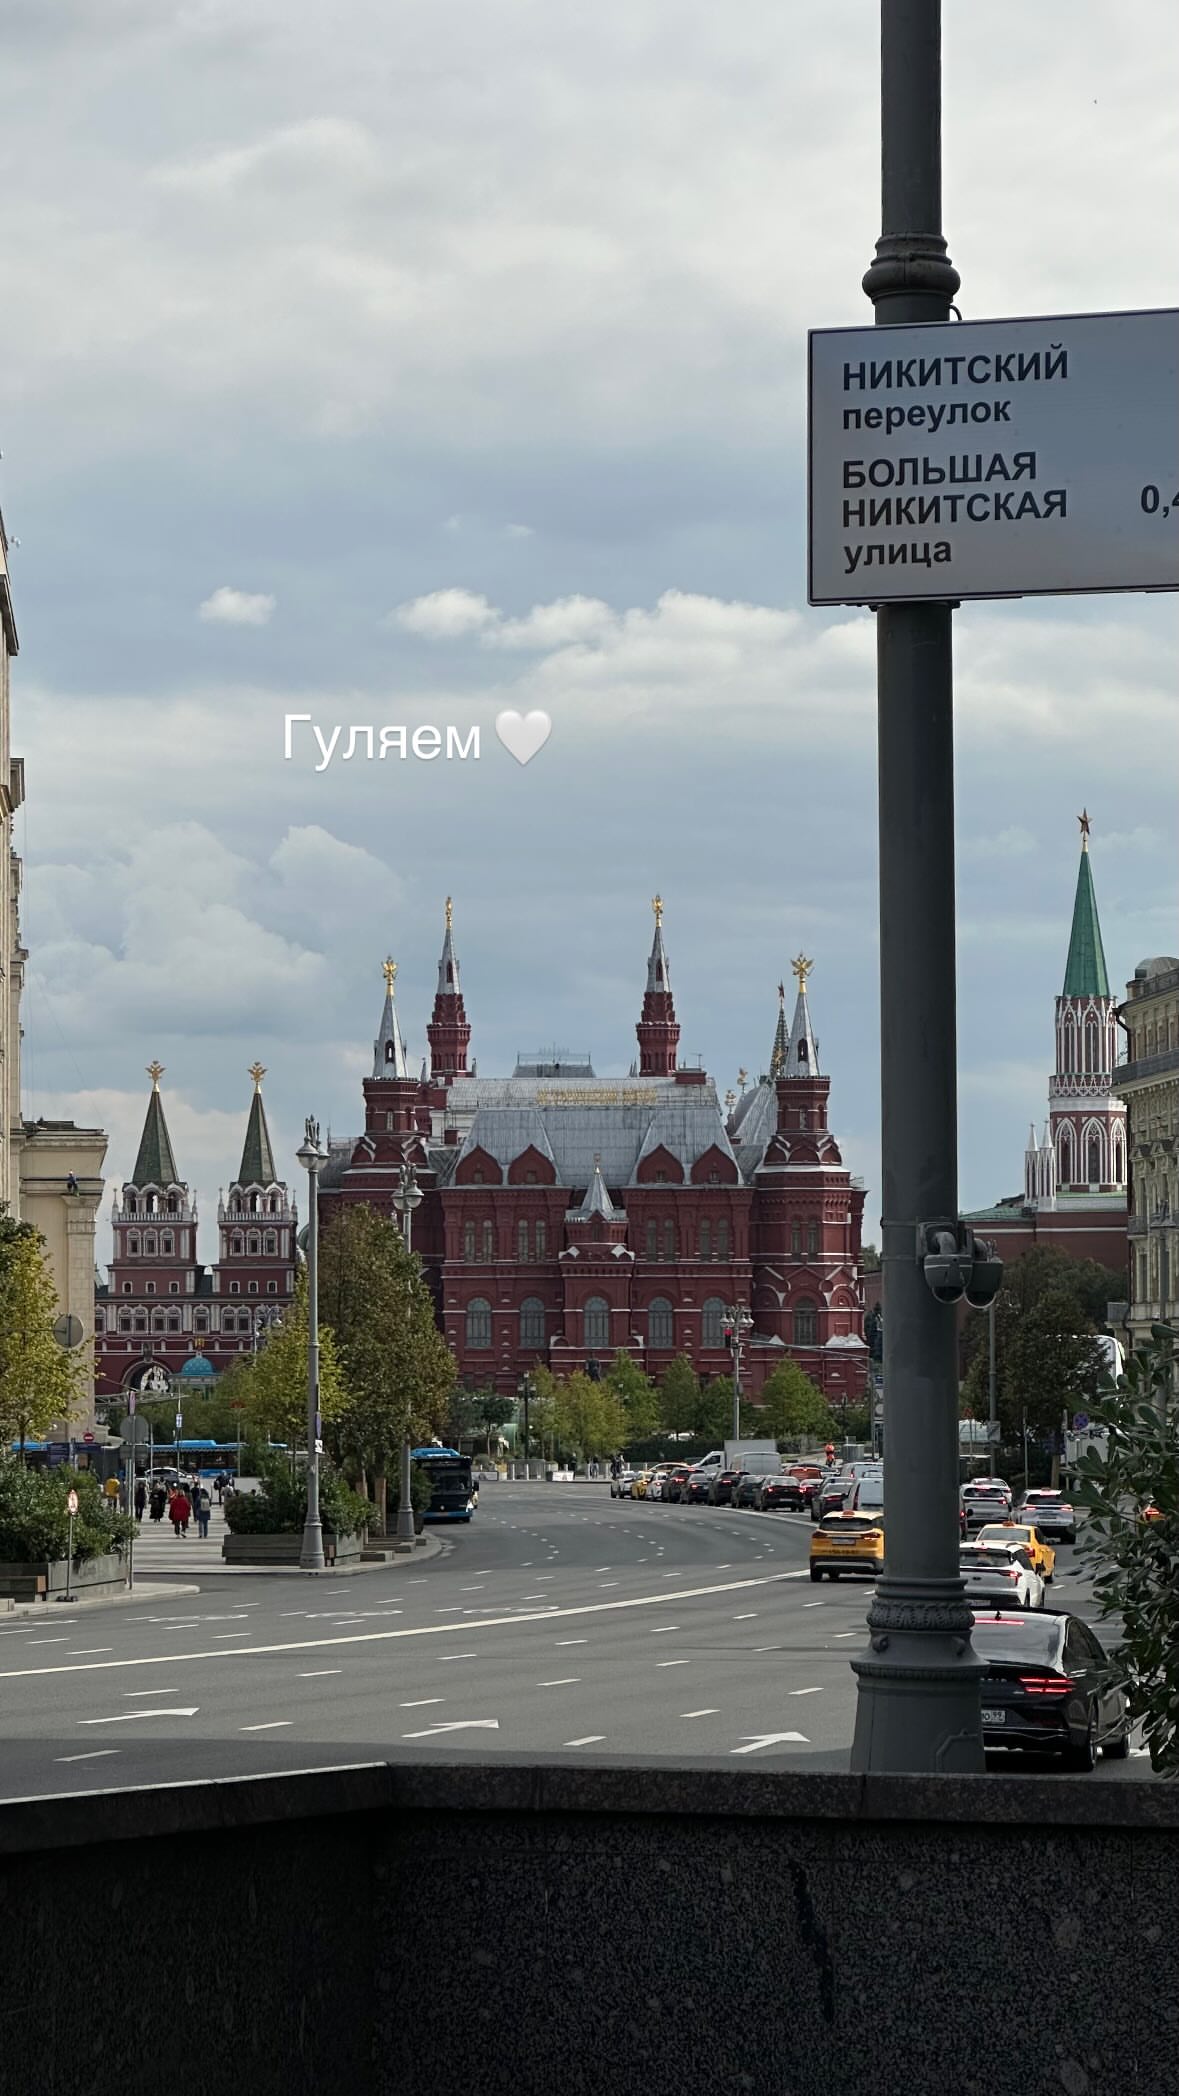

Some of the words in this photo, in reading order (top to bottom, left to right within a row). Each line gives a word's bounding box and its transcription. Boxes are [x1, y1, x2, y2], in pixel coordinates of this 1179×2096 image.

[843, 343, 1068, 391] НИКИТСКИЙ
[843, 400, 1011, 435] переулок
[843, 451, 1037, 489] БОЛЬШАЯ
[843, 489, 1067, 528] НИКИТСКАЯ
[843, 541, 952, 574] улица
